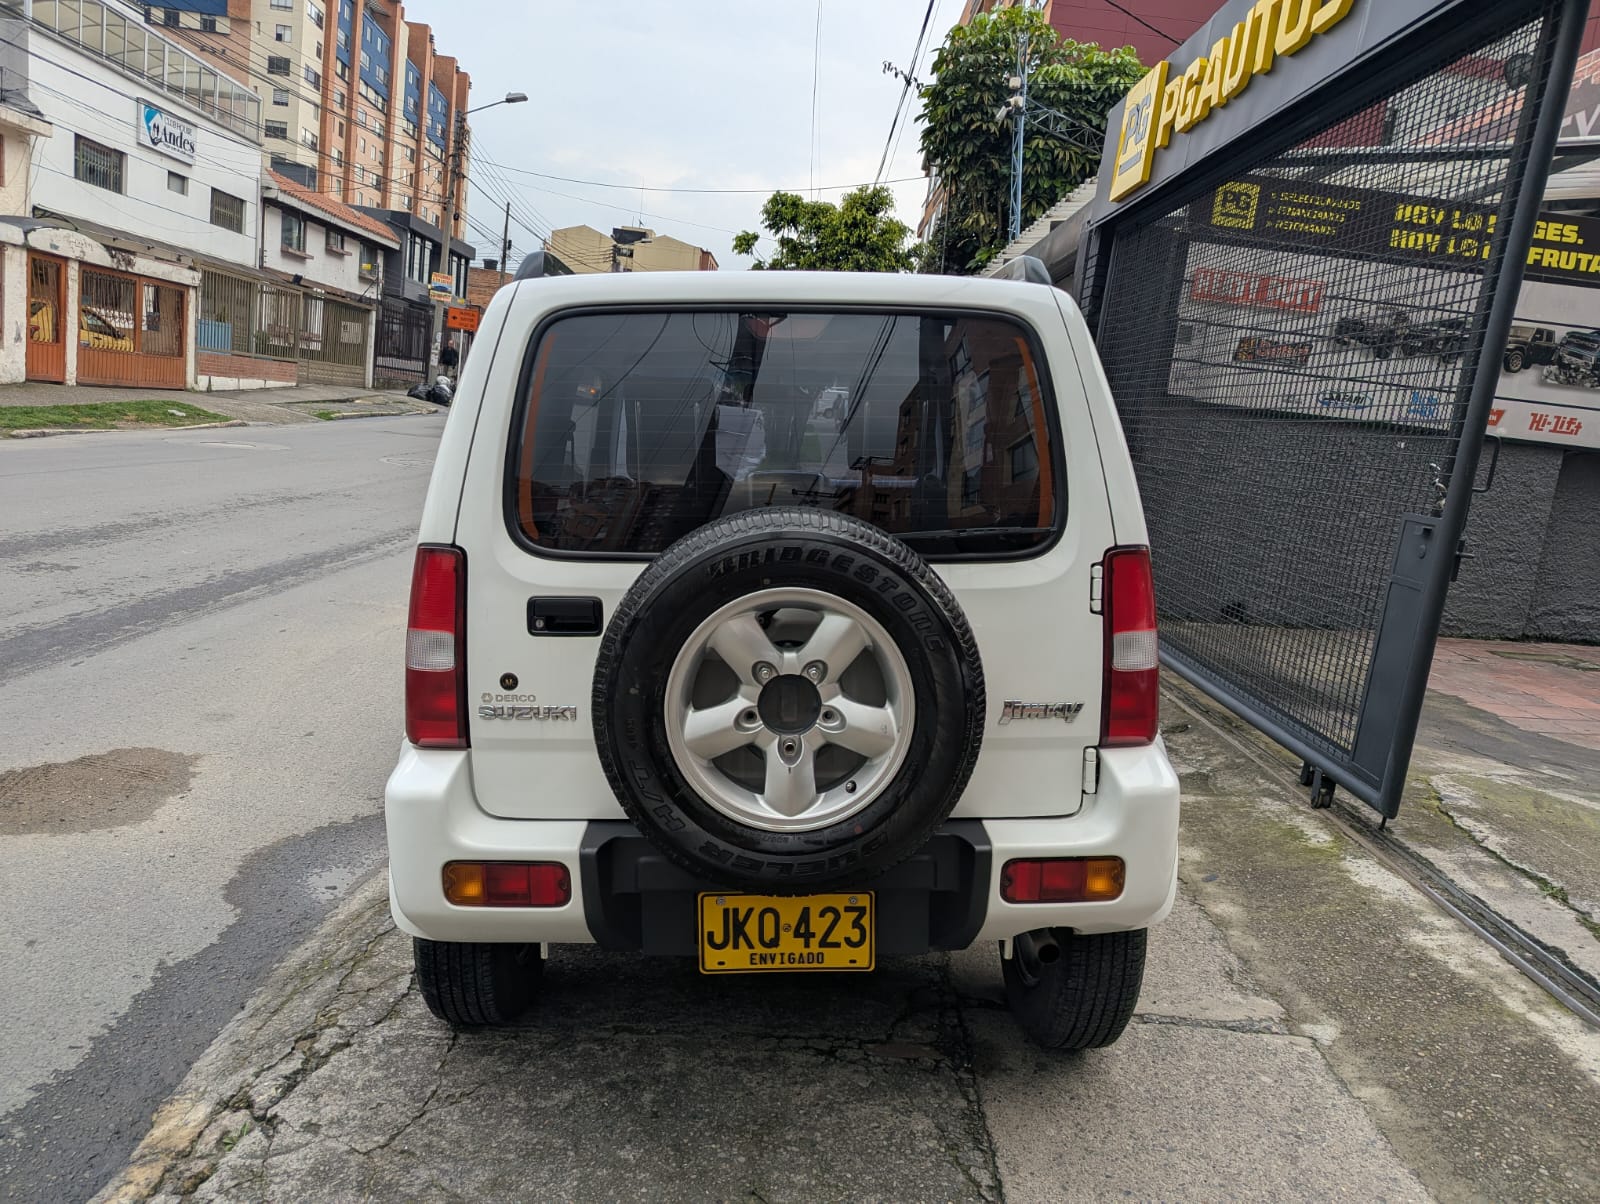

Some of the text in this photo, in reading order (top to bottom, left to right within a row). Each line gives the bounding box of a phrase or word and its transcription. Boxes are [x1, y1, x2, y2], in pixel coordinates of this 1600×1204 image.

[161, 125, 195, 153] Andes
[1395, 204, 1445, 225] HOY
[1389, 229, 1441, 252] HOY
[1529, 412, 1582, 435] Hi-Lift
[708, 546, 947, 653] BRIDGESTONE
[495, 694, 537, 703] DERCO
[478, 705, 577, 721] SUZUKI
[707, 906, 867, 950] JKQ 423
[750, 952, 825, 965] ENVIGADO
